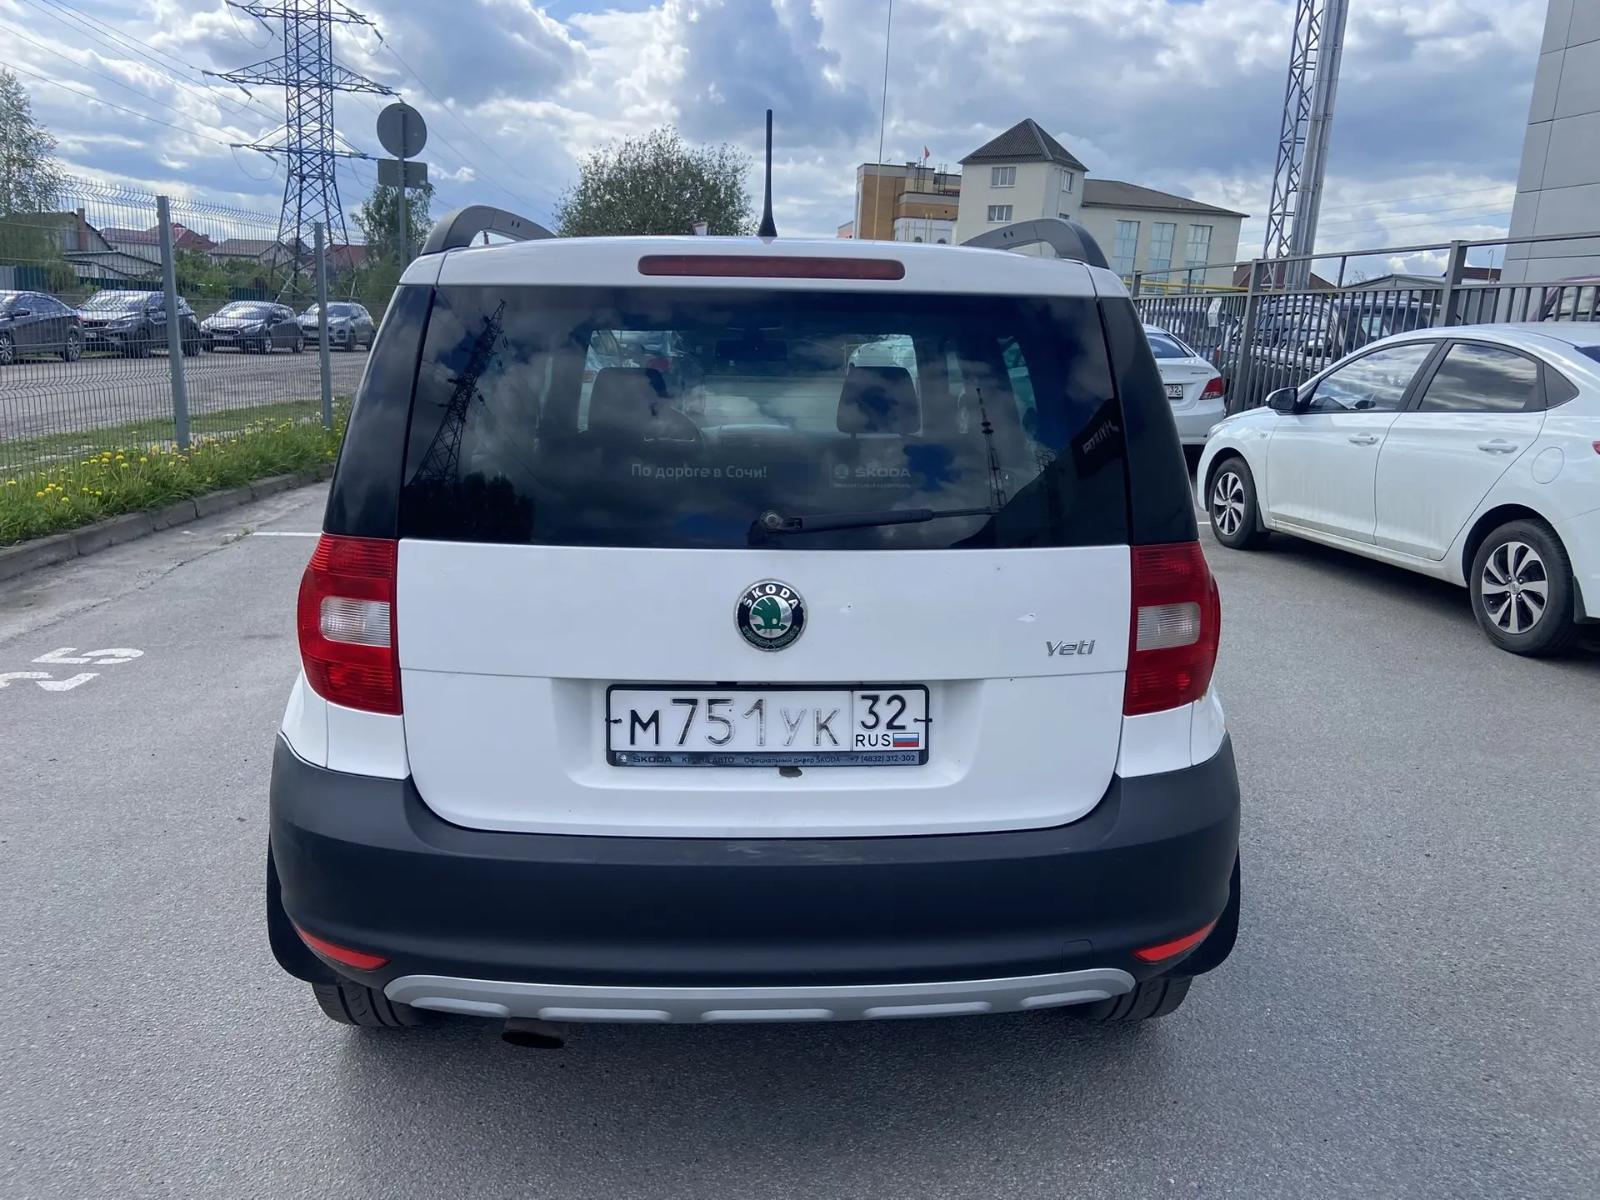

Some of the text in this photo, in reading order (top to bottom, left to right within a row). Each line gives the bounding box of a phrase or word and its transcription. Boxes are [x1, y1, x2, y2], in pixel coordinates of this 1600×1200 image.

[631, 463, 767, 480] По дороге в Сочи!
[1046, 640, 1096, 656] Yeti
[860, 694, 907, 730] 32
[855, 733, 891, 747] RUS
